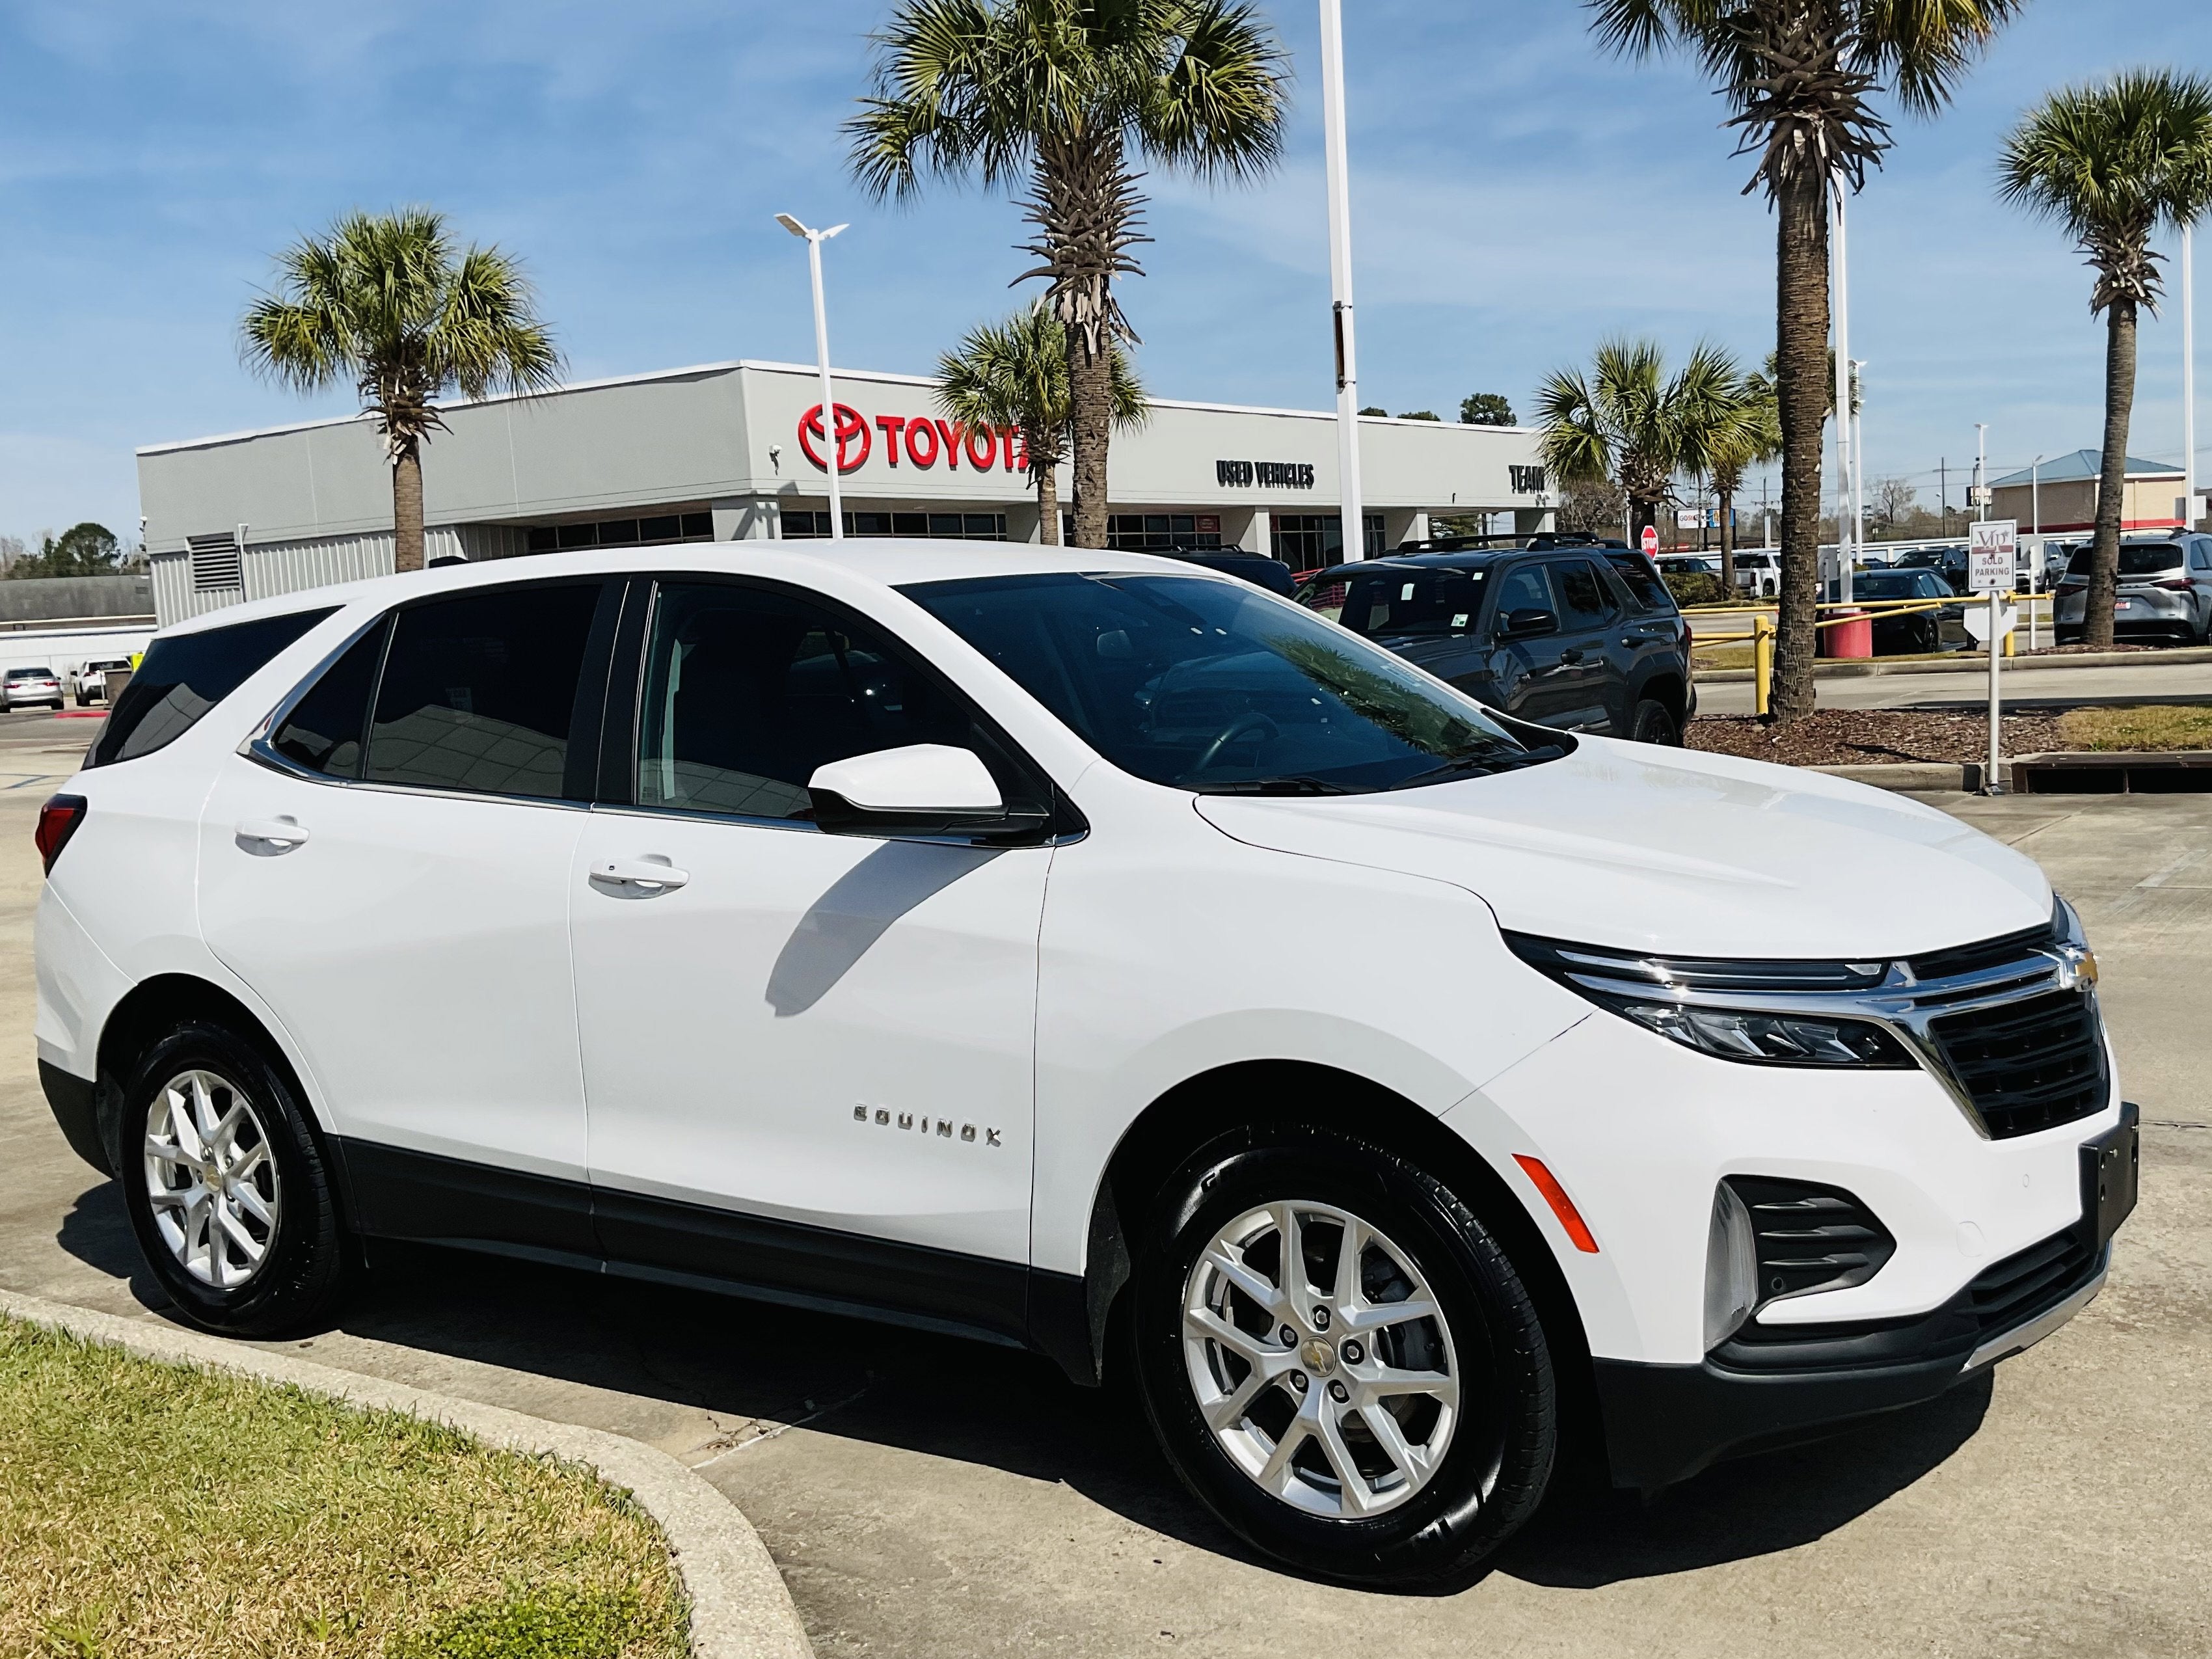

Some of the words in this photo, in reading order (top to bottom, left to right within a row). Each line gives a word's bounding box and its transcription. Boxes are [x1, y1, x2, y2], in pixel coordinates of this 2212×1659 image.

[1216, 460, 1253, 485] USED
[1254, 462, 1314, 487] VEHICLES
[1508, 465, 1546, 492] TEAM
[1643, 537, 1657, 549] STOP
[1975, 567, 2009, 576] PARKING
[854, 1103, 1001, 1147] EQUINOX
